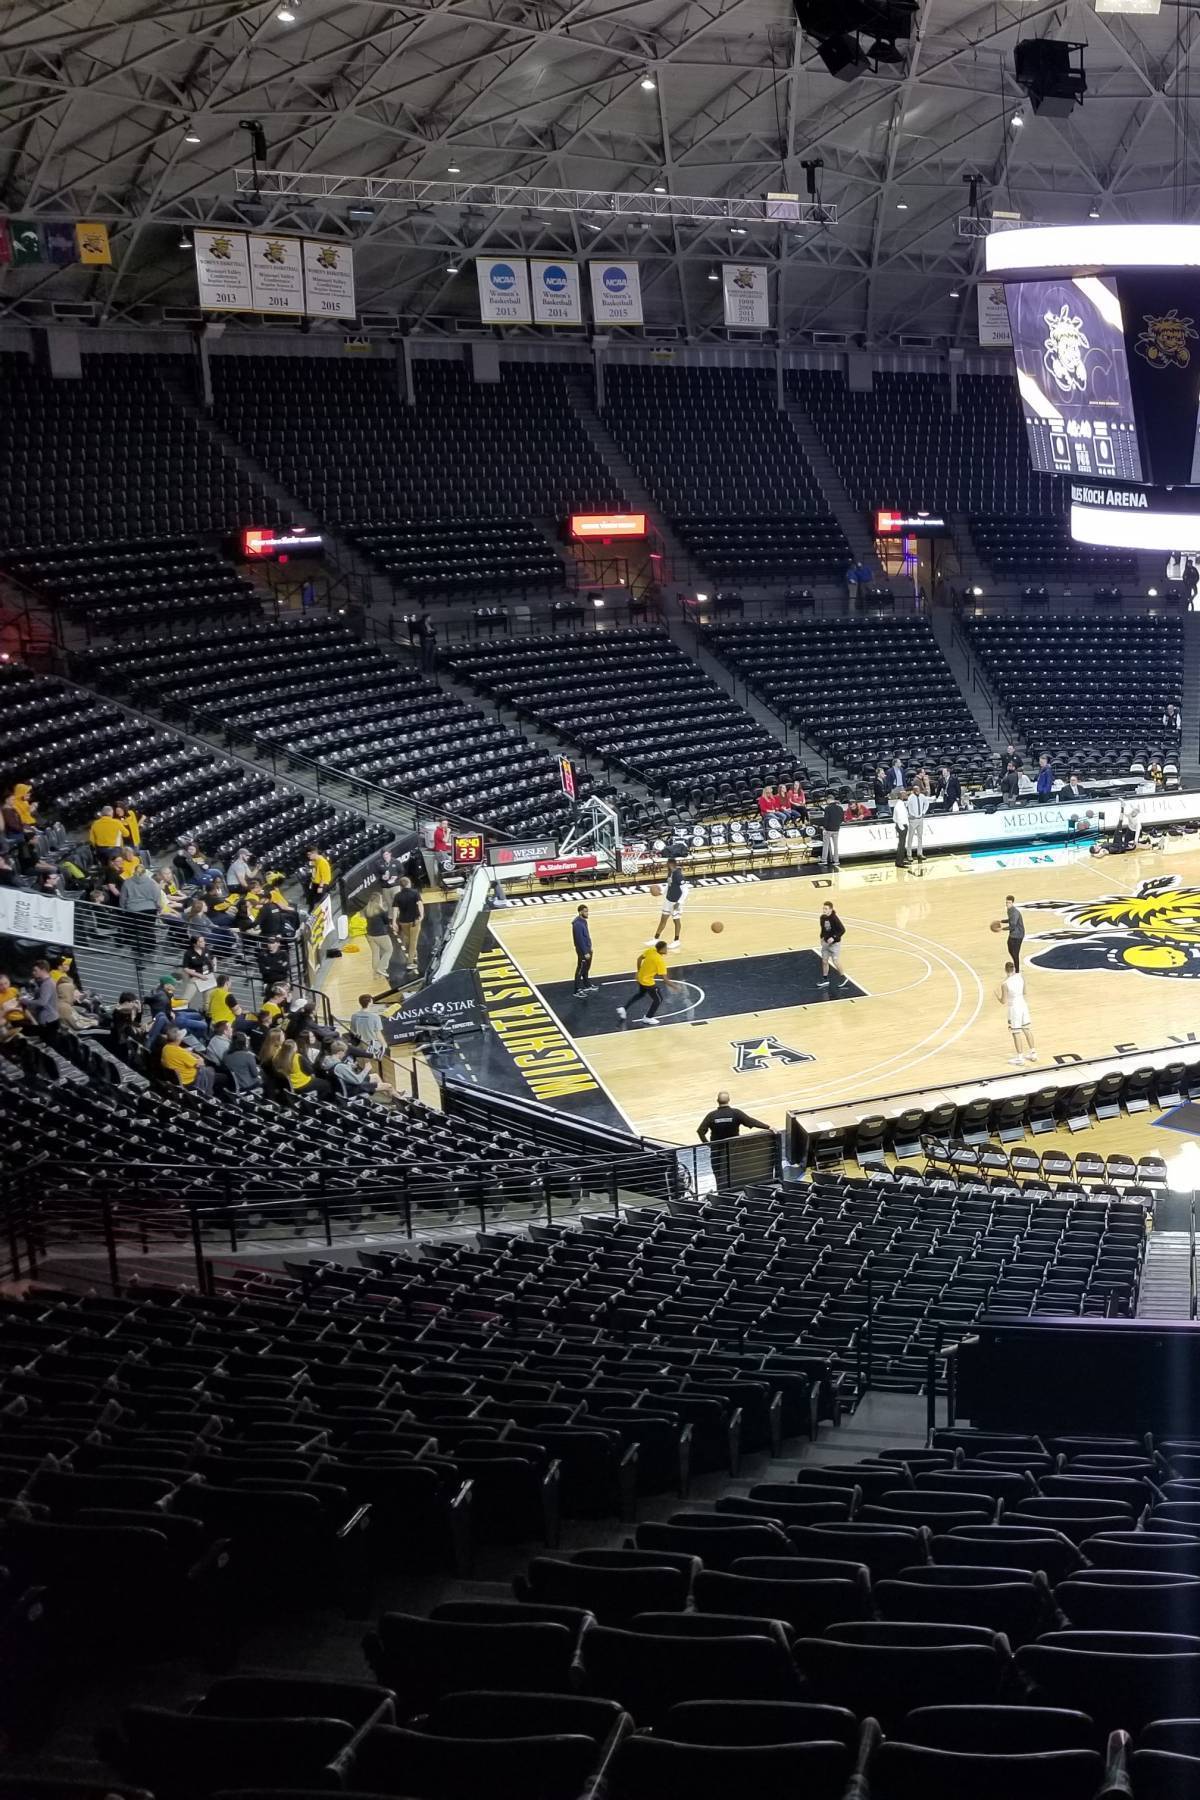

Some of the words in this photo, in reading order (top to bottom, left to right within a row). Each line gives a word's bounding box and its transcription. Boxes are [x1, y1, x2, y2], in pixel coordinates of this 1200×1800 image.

[216, 293, 236, 303] 2013
[269, 297, 288, 306] 2014
[322, 301, 340, 311] 2015
[496, 308, 517, 316] 2013
[548, 309, 568, 317] 2014
[1056, 437, 1064, 455] 0
[1100, 440, 1108, 459] 0
[1083, 487, 1104, 504] KOCH
[1106, 490, 1148, 507] ARENA
[1004, 811, 1065, 827] MEDICA
[460, 848, 476, 858] 23
[513, 847, 548, 857] WESLEY
[389, 1006, 432, 1021] KANSAS
[446, 1000, 476, 1012] STAR
